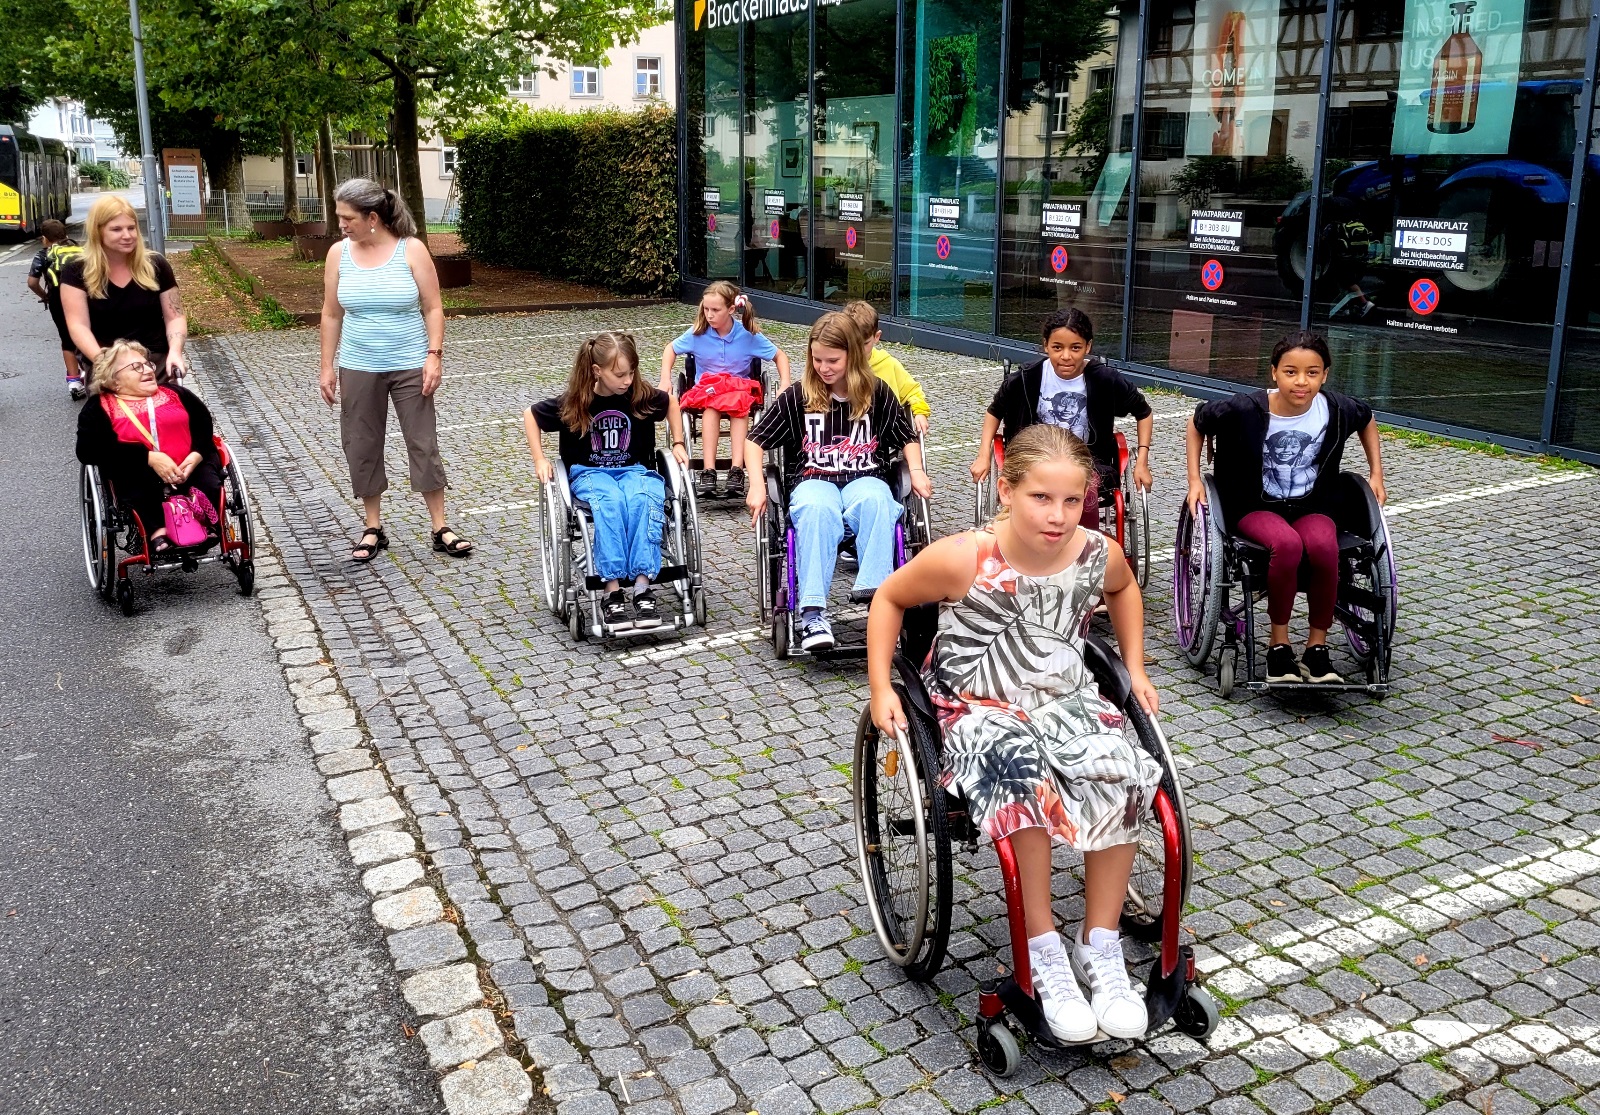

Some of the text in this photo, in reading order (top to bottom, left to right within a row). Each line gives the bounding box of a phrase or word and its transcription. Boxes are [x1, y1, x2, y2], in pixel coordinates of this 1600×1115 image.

[1411, 10, 1502, 38] INSPIRED
[1410, 47, 1435, 69] US
[1202, 67, 1245, 87] COME
[1043, 203, 1081, 211] PRIVATPARKPLATZ
[1191, 210, 1243, 219] PRIVATPARKPLATZ
[1396, 219, 1469, 231] PRIVATPARKPLATZ
[1407, 235, 1418, 244] FK
[1433, 237, 1452, 246] DOS
[1400, 250, 1458, 262] bei Nichtbeachtung
[1392, 258, 1465, 270] BESITZSTÖRUNGSKLAGE
[1386, 319, 1458, 334] Halten und Parken verboten
[599, 416, 624, 430] LEVEL
[602, 429, 619, 449] 10
